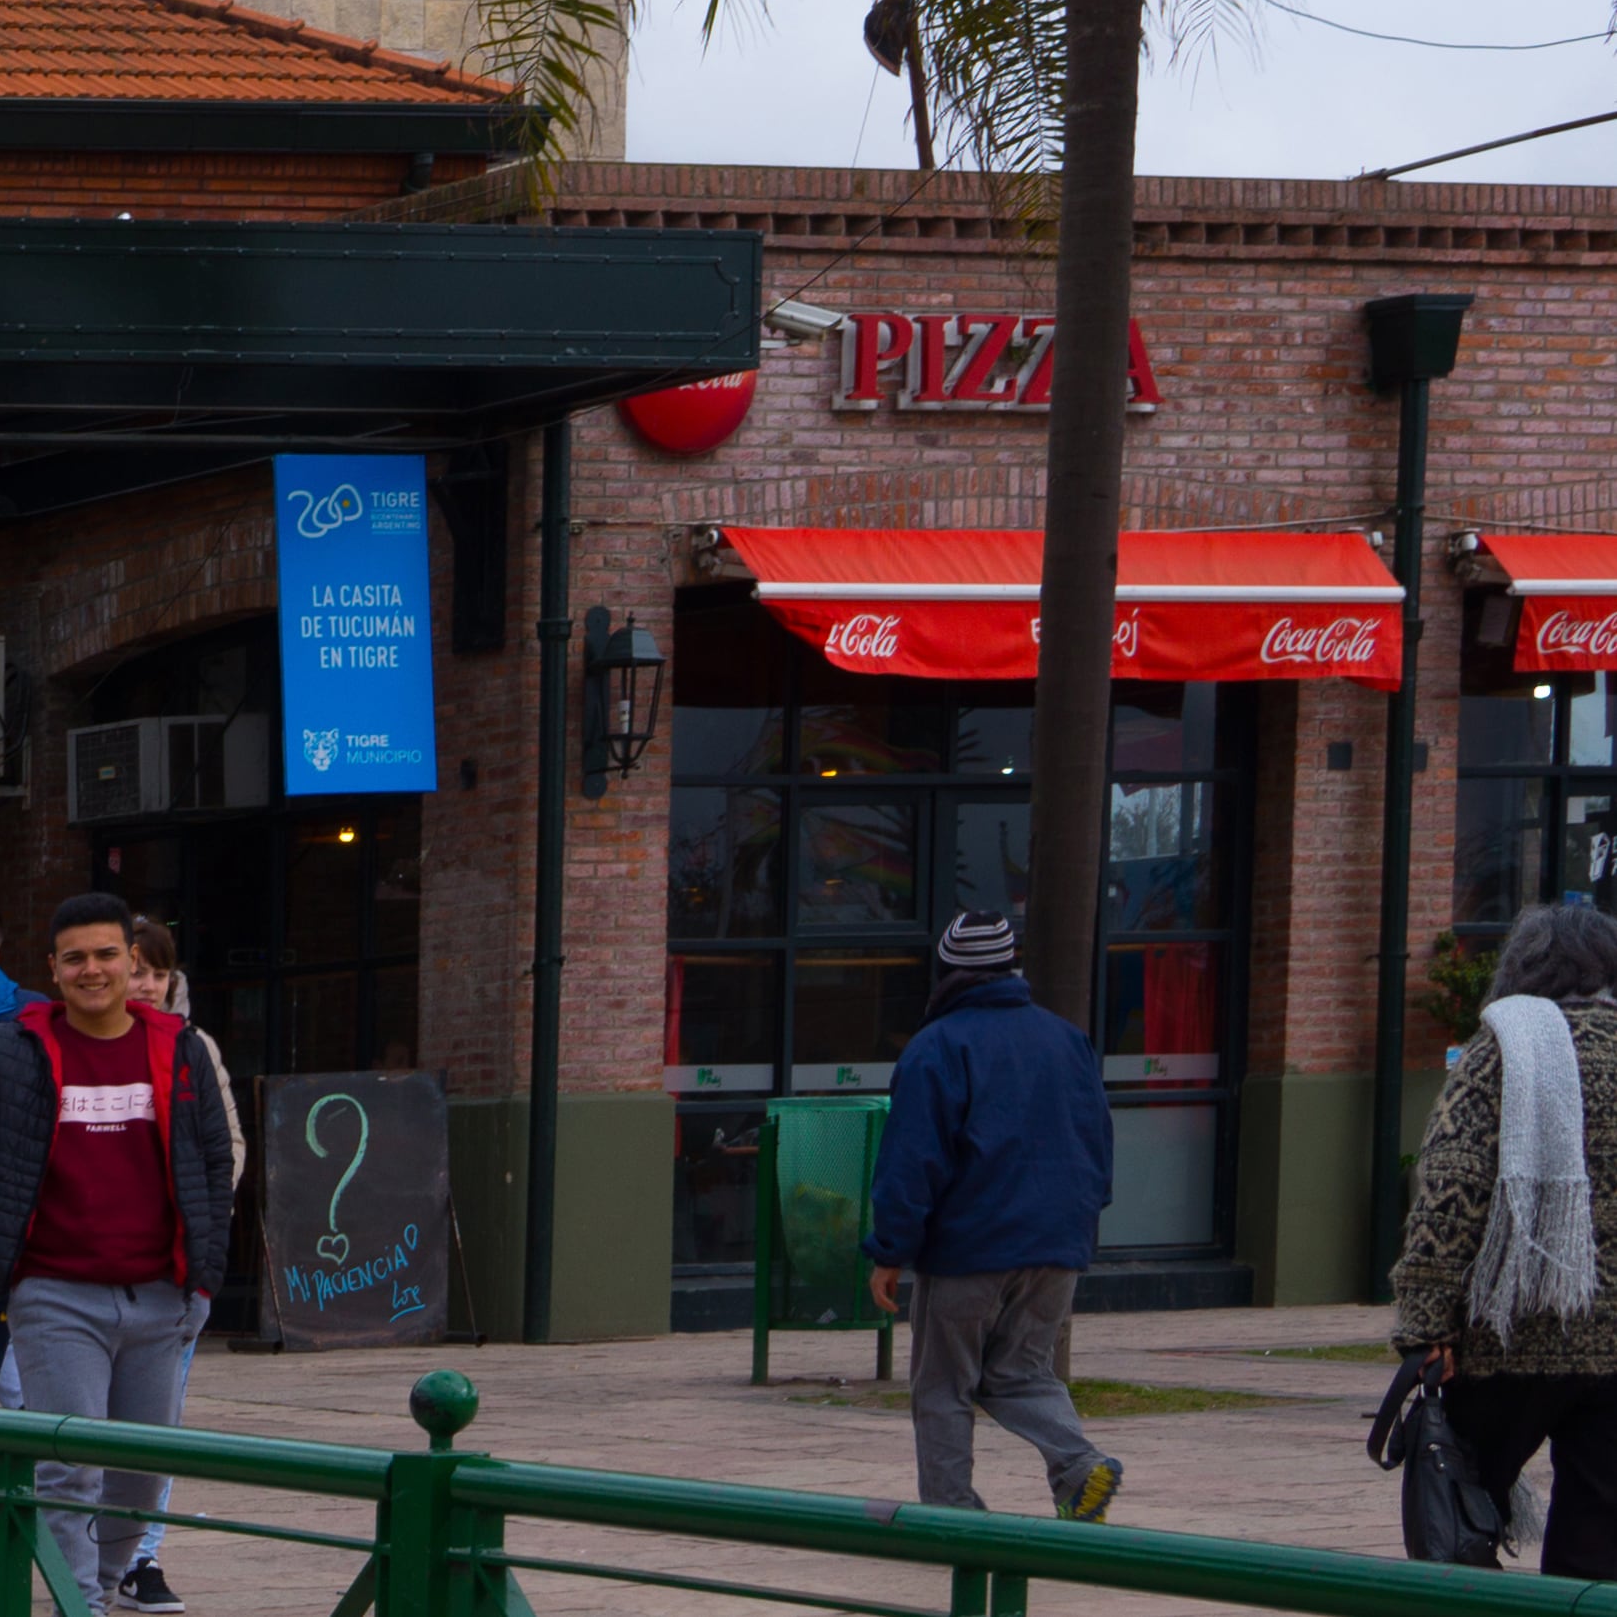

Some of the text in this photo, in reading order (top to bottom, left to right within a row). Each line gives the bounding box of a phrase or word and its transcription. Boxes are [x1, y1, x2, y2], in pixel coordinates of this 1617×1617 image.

[370, 491, 420, 508] TIGRE
[312, 584, 403, 608] LA CASITA
[301, 610, 415, 639] DE TUCUMÁN
[1536, 610, 1617, 656] Coca-Co
[1260, 616, 1382, 663] Coca-Cola
[320, 645, 399, 669] EN TIGRE
[346, 734, 390, 748] TIGRE
[347, 750, 422, 765] MUNICIPIO
